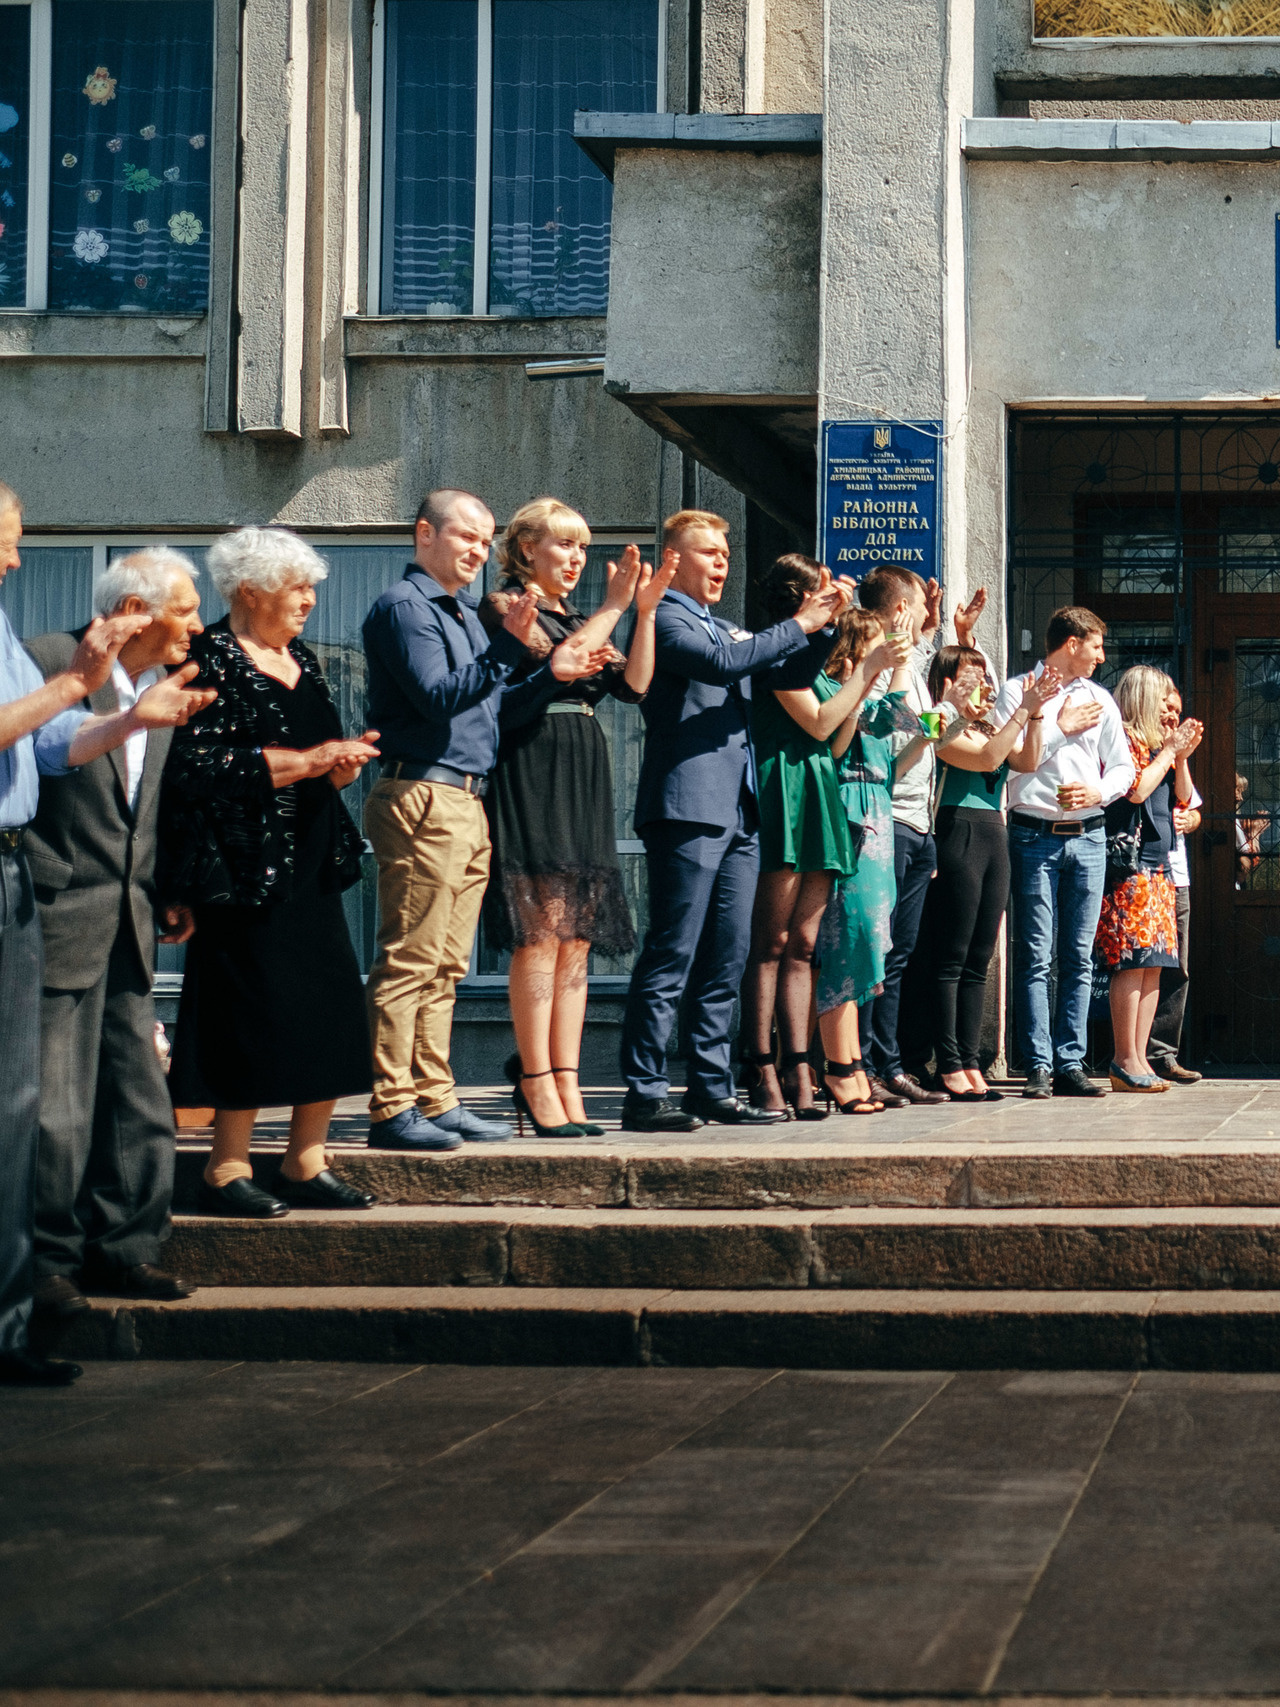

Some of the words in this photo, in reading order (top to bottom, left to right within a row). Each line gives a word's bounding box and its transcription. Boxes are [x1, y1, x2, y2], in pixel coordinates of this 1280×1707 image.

[843, 498, 919, 514] РАЙОННА
[832, 517, 930, 529] БІБЛІОТЕКА
[865, 533, 896, 546] ДЛЯ
[837, 549, 924, 562] ДОРОСЛИХ
